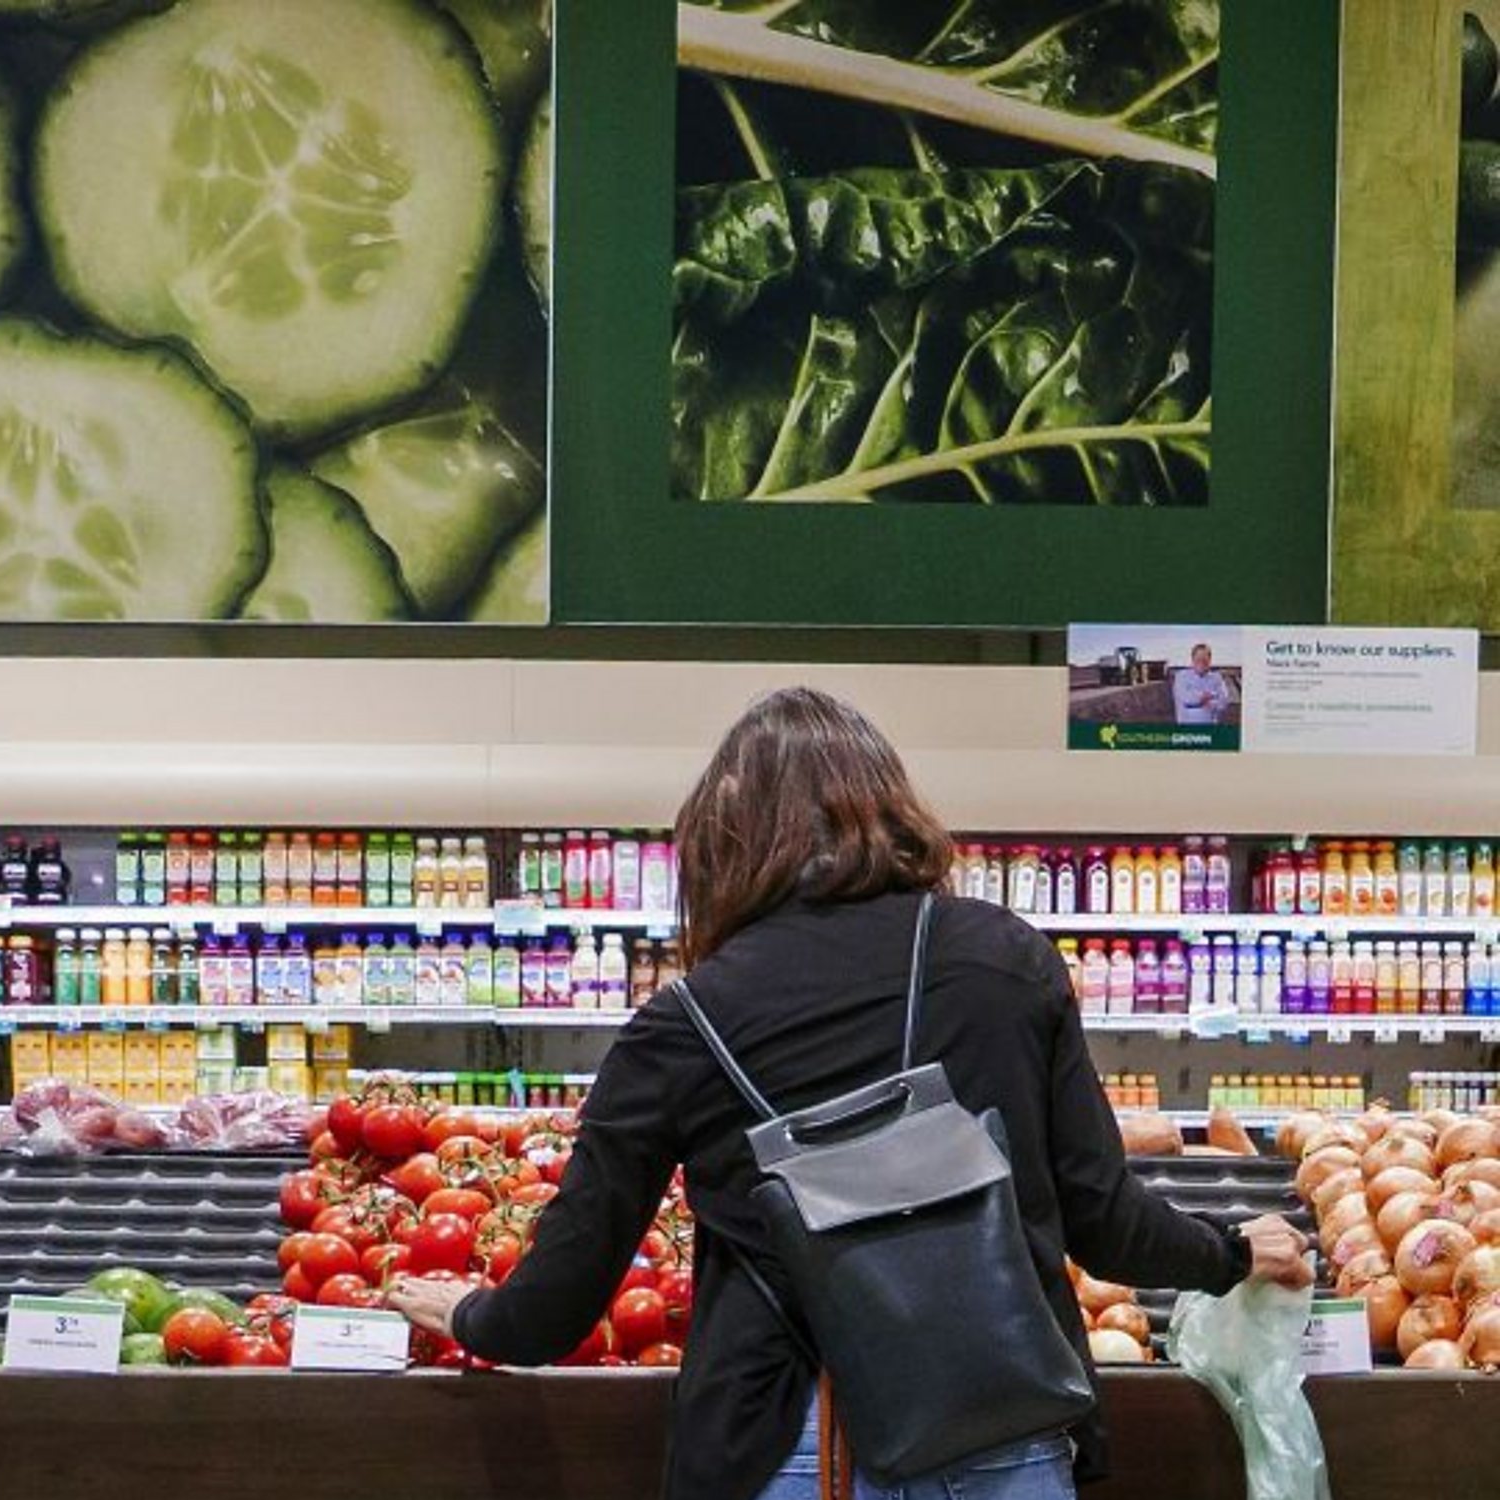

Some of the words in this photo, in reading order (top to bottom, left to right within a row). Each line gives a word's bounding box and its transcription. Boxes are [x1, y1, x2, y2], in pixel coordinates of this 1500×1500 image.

[1265, 641, 1293, 655] Get
[1297, 644, 1312, 656] to
[1316, 641, 1356, 656] know
[1360, 645, 1384, 657] our
[1388, 643, 1455, 660] suppliers.
